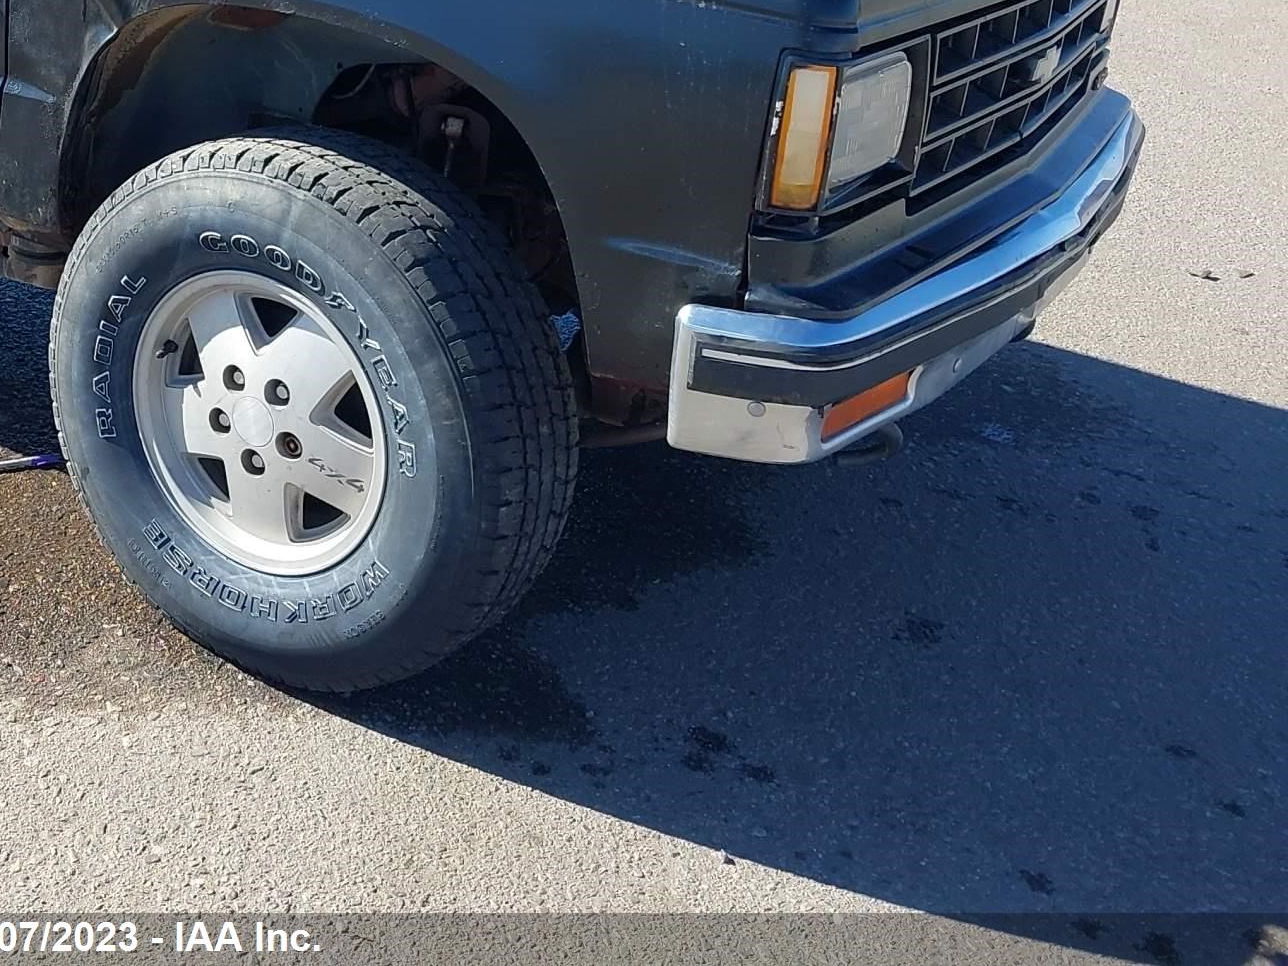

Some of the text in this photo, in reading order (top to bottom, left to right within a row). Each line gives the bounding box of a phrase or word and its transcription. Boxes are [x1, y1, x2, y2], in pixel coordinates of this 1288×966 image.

[92, 274, 147, 439] RADIAL
[199, 231, 418, 478] GOODYEAR
[142, 518, 392, 624] WORKHORSE
